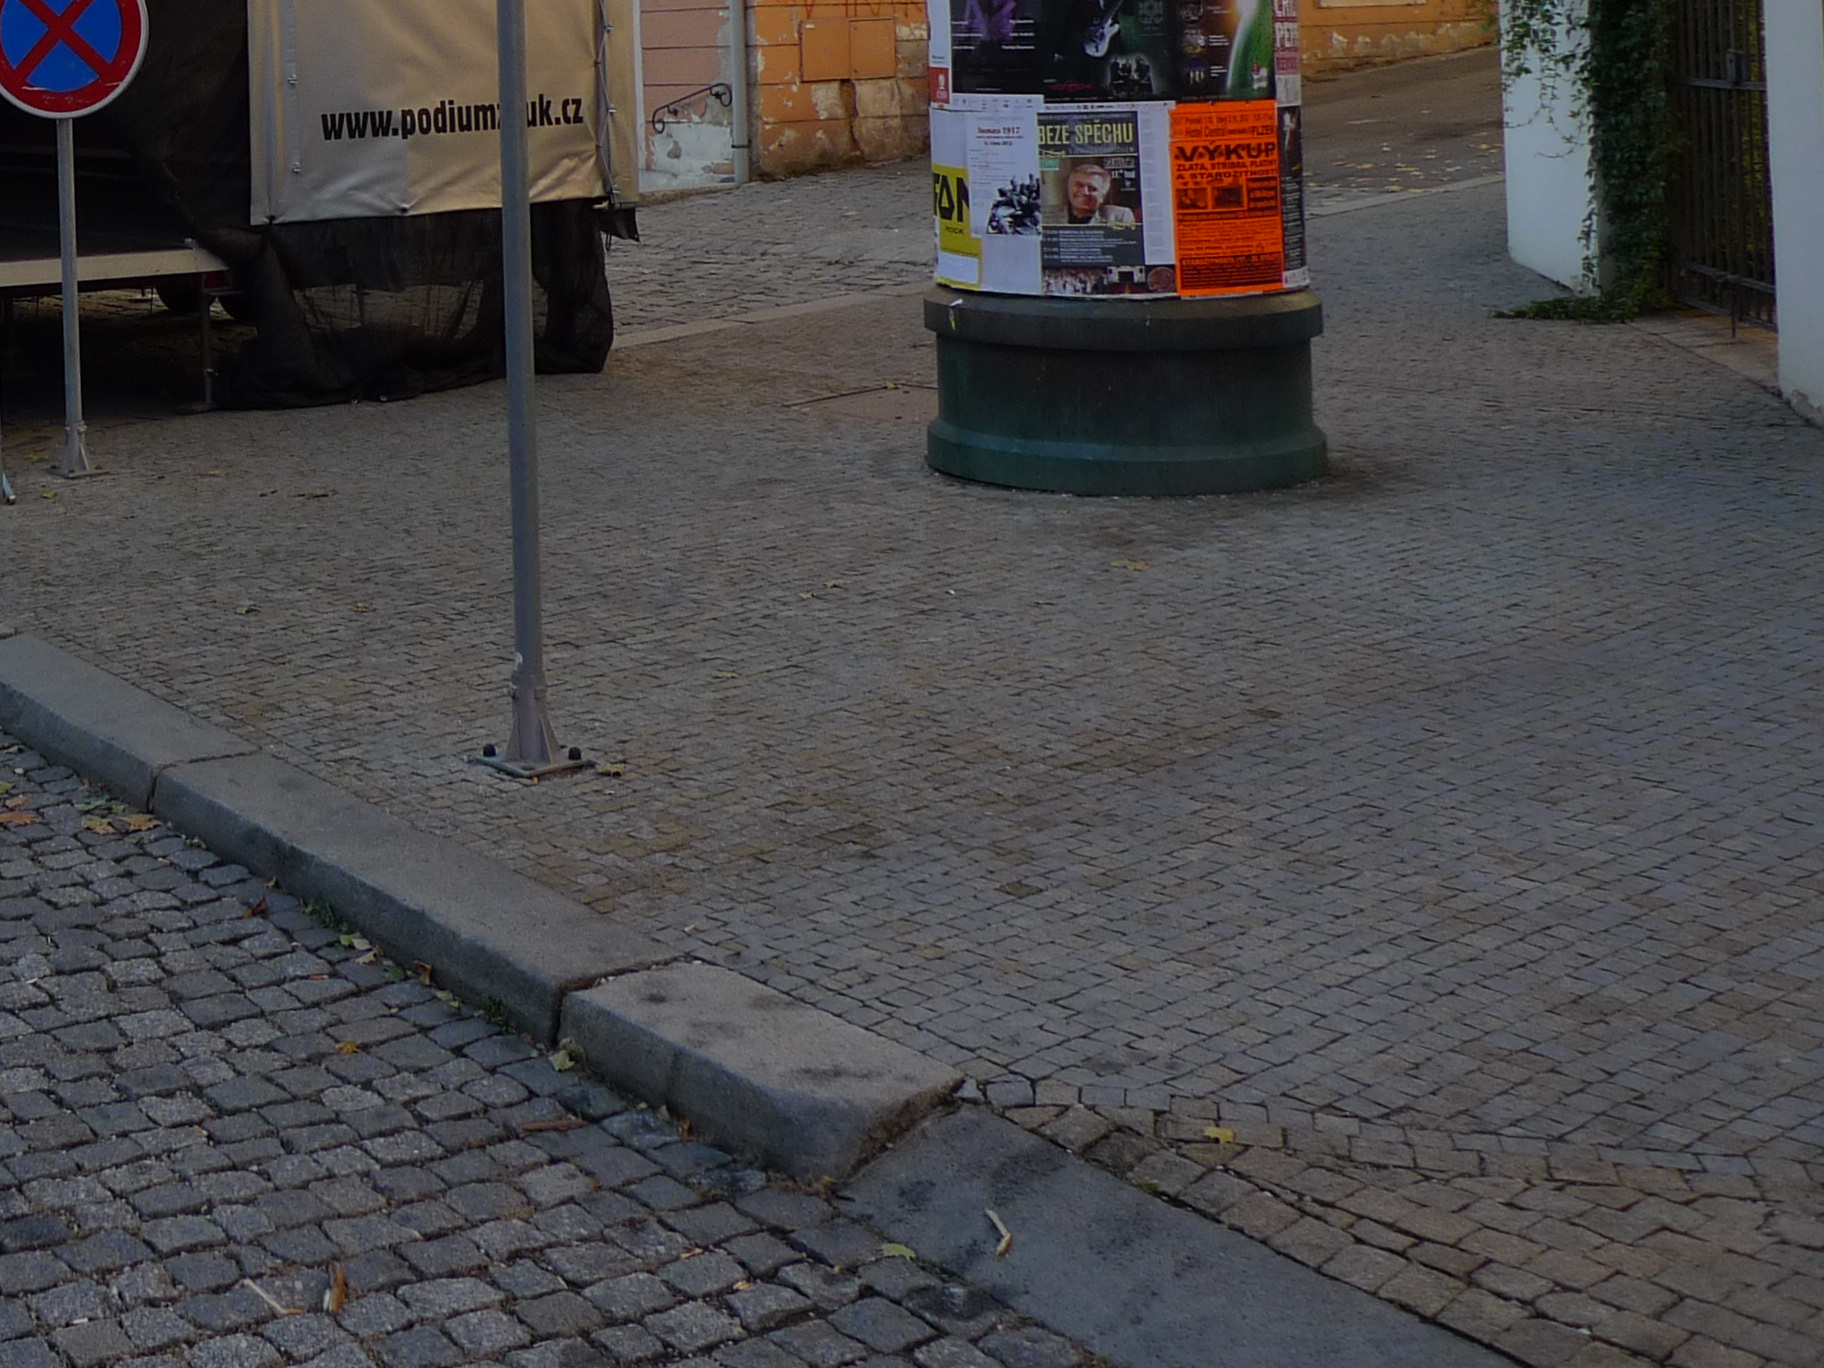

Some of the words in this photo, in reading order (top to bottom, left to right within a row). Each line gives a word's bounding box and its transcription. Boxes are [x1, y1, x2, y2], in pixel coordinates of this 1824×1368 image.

[320, 93, 584, 141] www.podiumuk.cz
[1037, 124, 1071, 145] BEZE
[1075, 119, 1134, 144] SPĚCHU
[1175, 140, 1276, 163] VÝKUP
